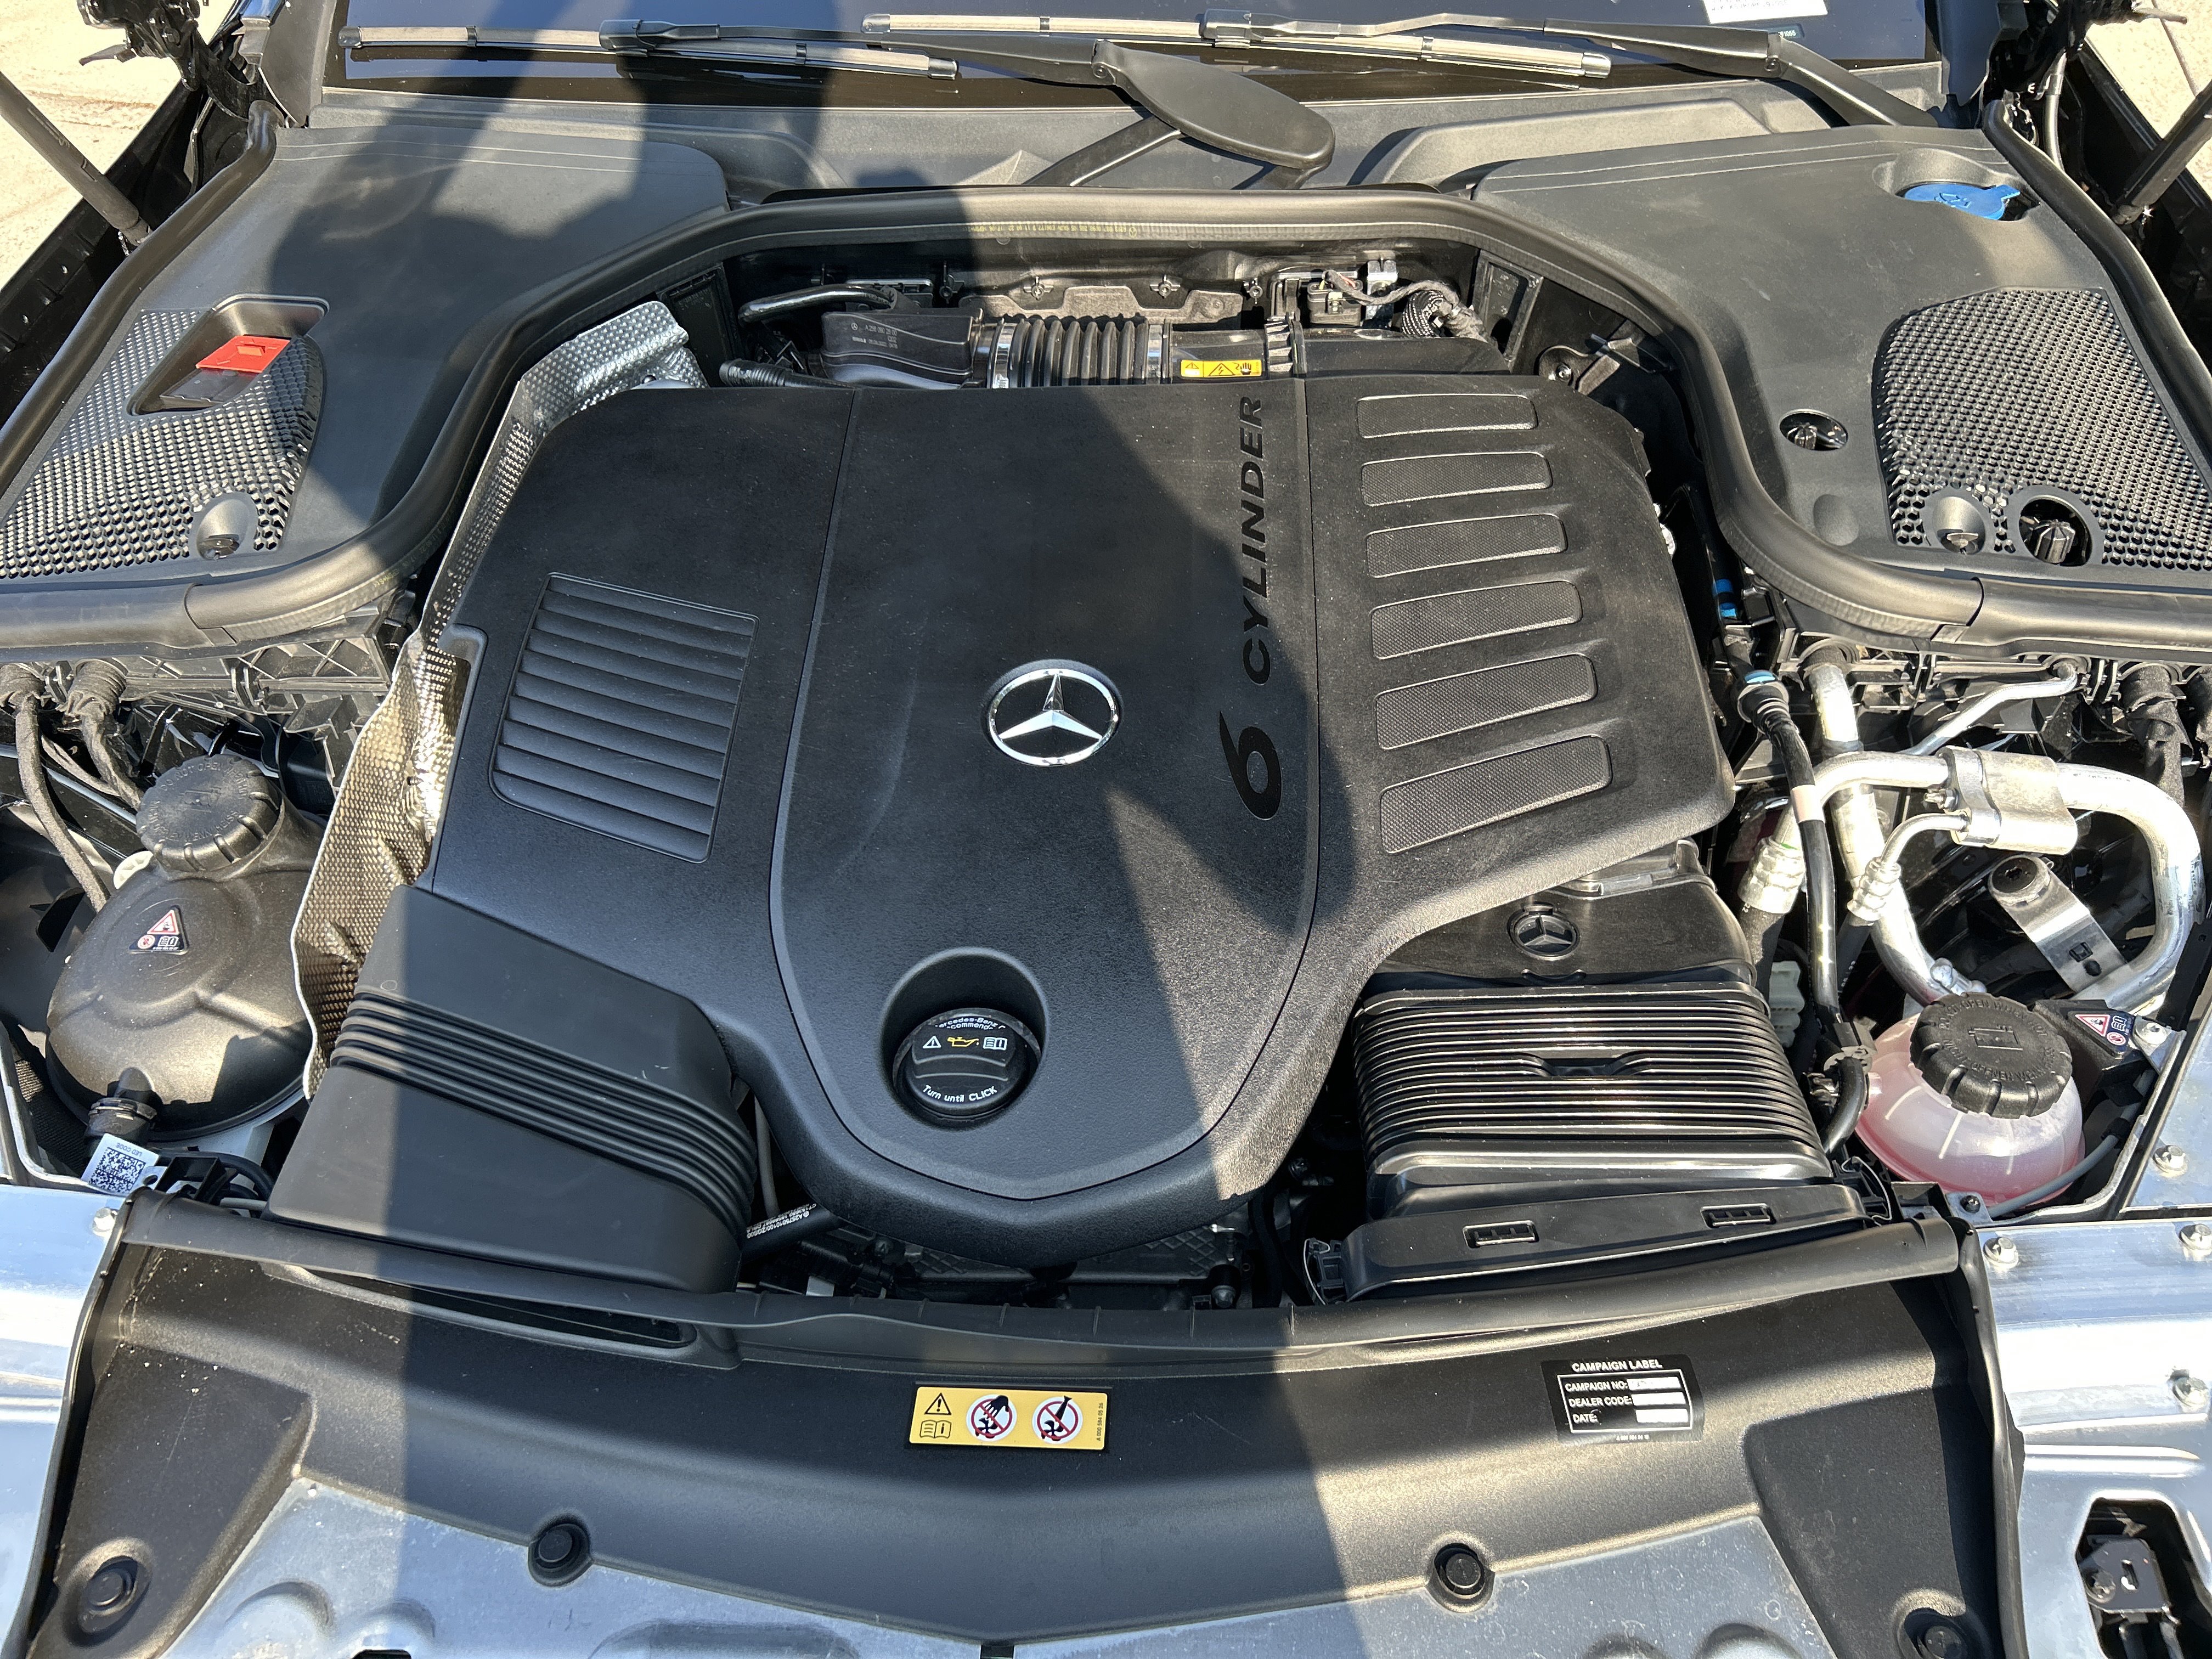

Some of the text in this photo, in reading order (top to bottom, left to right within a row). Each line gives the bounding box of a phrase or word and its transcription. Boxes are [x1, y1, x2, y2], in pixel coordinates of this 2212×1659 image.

[1219, 396, 1283, 821] 6 CYLINDER
[176, 765, 194, 781] NOT
[935, 1017, 998, 1028] ercedes-Benz
[923, 1084, 998, 1103] Turn until CLICK
[115, 1142, 132, 1153] CODE
[1572, 1359, 1662, 1372] CAMPAIGN LABEL
[1565, 1380, 1628, 1392] CAMPAIGN NO:
[1568, 1396, 1633, 1408] DEALER CODE:
[1572, 1413, 1598, 1424] DATE:
